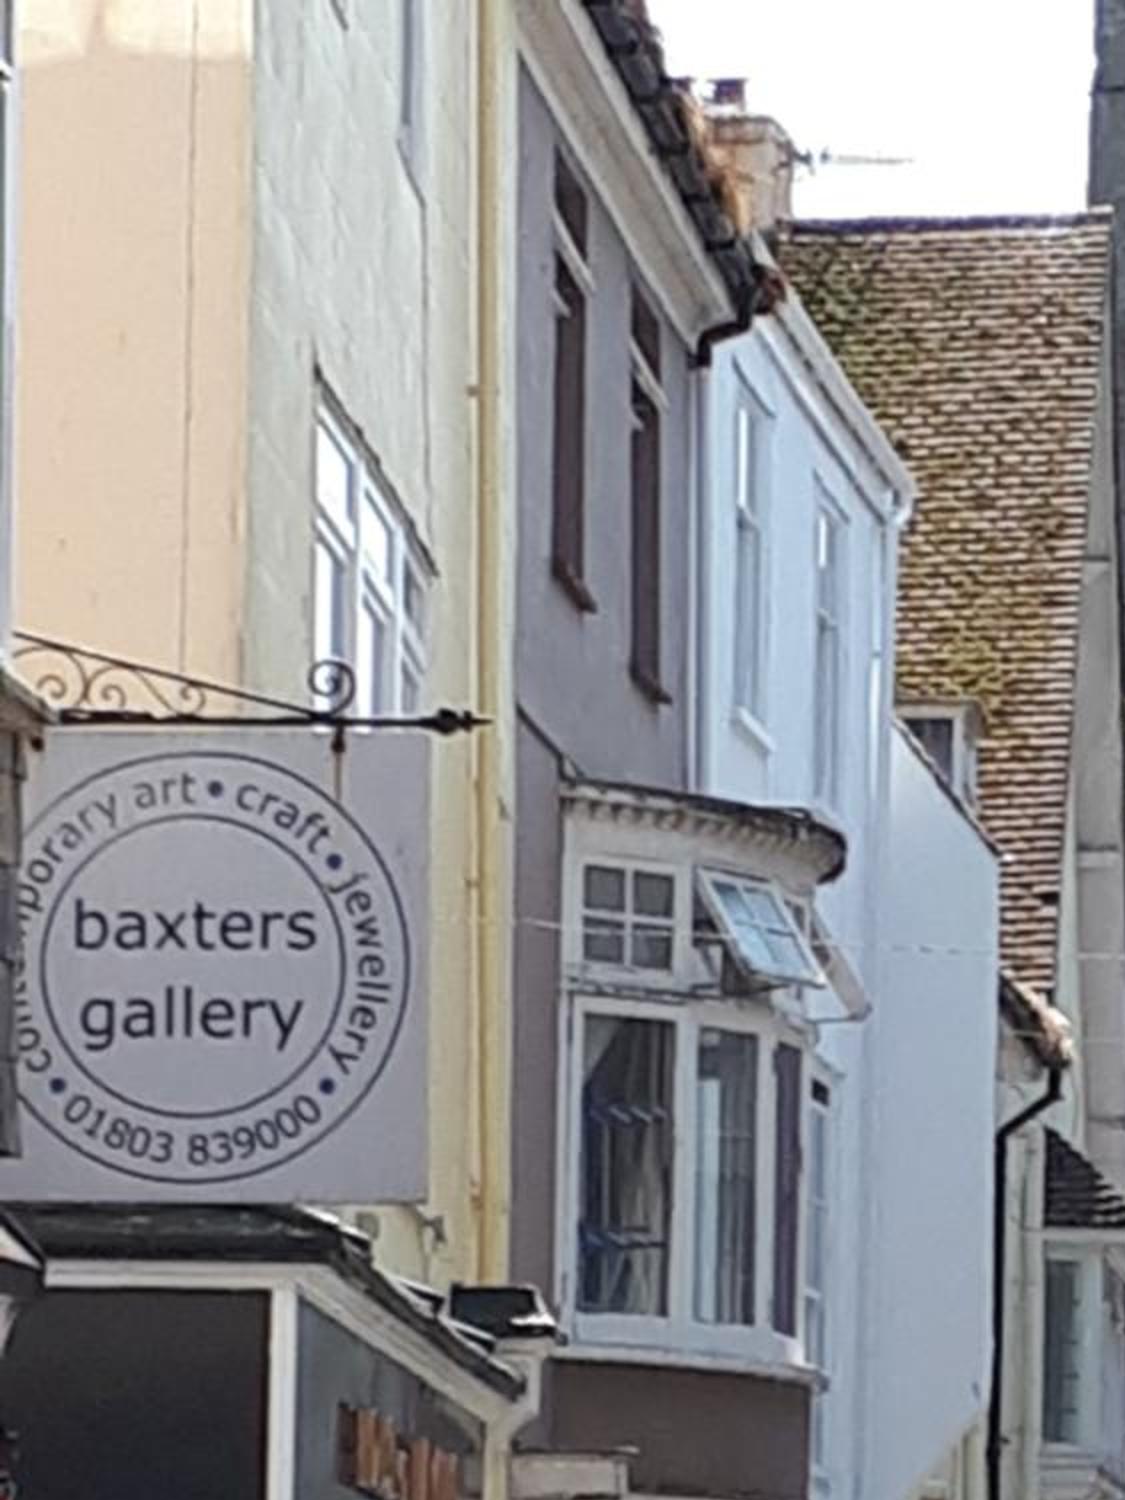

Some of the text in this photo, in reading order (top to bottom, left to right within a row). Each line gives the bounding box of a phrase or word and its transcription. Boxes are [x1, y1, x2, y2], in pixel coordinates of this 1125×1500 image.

[134, 772, 198, 808] art
[236, 782, 334, 856] craft
[74, 897, 318, 951] baxters
[329, 872, 392, 1076] jewellery
[80, 985, 304, 1052] gallery
[63, 1094, 322, 1166] 01803 839000
